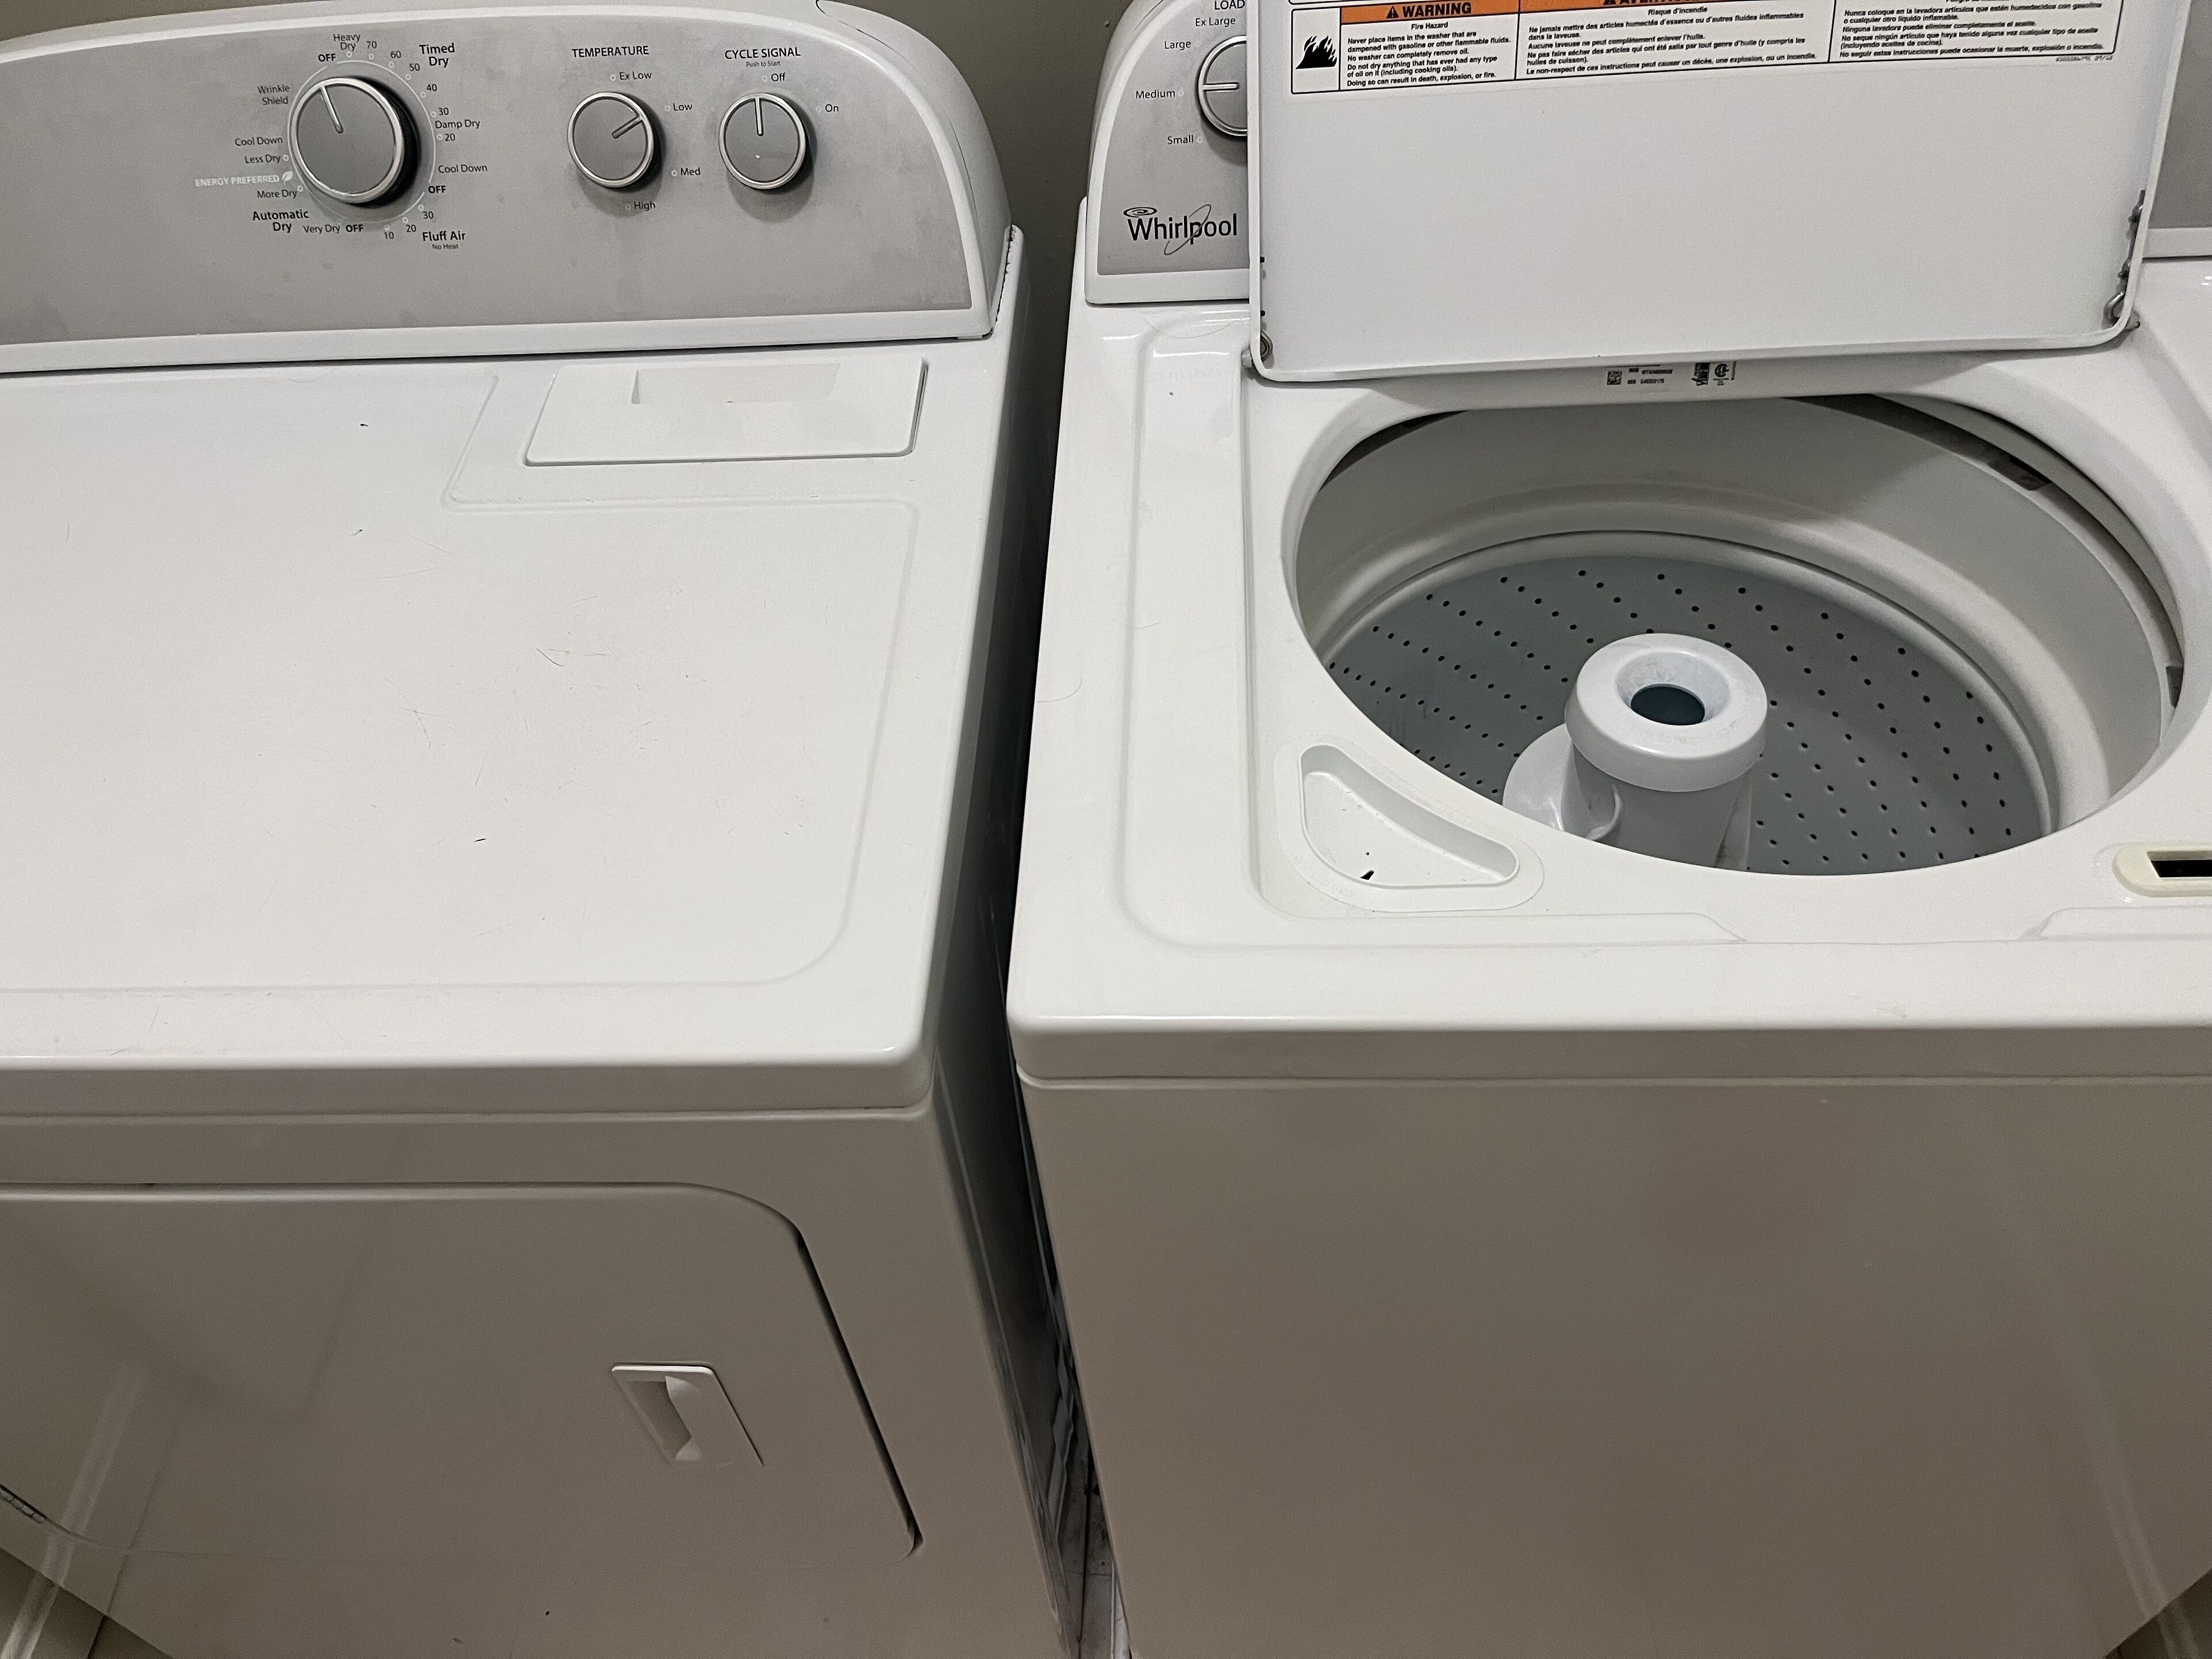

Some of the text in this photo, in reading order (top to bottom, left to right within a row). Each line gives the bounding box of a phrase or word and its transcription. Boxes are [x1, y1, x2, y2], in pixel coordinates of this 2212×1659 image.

[1215, 0, 1245, 10] LOAD
[1403, 2, 1471, 18] WARNING
[1196, 17, 1236, 27] Ex Large
[333, 34, 361, 43] Heavy
[1368, 36, 1385, 44] place
[340, 42, 355, 51] Dry
[366, 41, 377, 49] 70
[419, 42, 455, 54] Timed
[1165, 41, 1191, 51] Large
[1347, 44, 1381, 53] dampened
[1398, 42, 1426, 51] gasoline
[571, 46, 649, 58] TEMPERATURE
[725, 47, 801, 59] CYCLE SIGNAL
[1396, 50, 1432, 59] completely
[318, 54, 336, 62] OFF
[429, 56, 449, 68] Dry
[410, 63, 420, 71] 50
[1382, 60, 1410, 69] anything
[619, 71, 652, 80] Ex Low
[1380, 68, 1413, 77] (including
[771, 73, 786, 82] Off
[257, 85, 290, 94] Wrinkle
[426, 84, 437, 92] 40
[1136, 89, 1175, 99] Medium
[262, 96, 288, 105] Shield
[438, 107, 449, 115] 30
[673, 103, 692, 111] Low
[825, 104, 839, 112] On
[435, 119, 480, 129] Damp Dry
[235, 137, 283, 146] Cool Down
[445, 133, 455, 141] 20
[1168, 135, 1194, 145] Small
[245, 154, 281, 164] Less Dry
[438, 164, 487, 173] Cool Down
[681, 167, 700, 176] Med
[195, 175, 279, 187] ENERGY PREFERRED
[428, 185, 446, 194] OFF
[282, 190, 297, 199] Dry
[634, 200, 656, 211] High
[253, 209, 309, 221] Automatic
[423, 211, 434, 219] 30
[272, 222, 291, 233] Dry
[303, 224, 340, 234] Very Dry
[346, 224, 363, 232] OFF
[406, 224, 416, 232] 20
[1127, 213, 1237, 245] Whirlpool
[422, 230, 465, 241] Fluff Air
